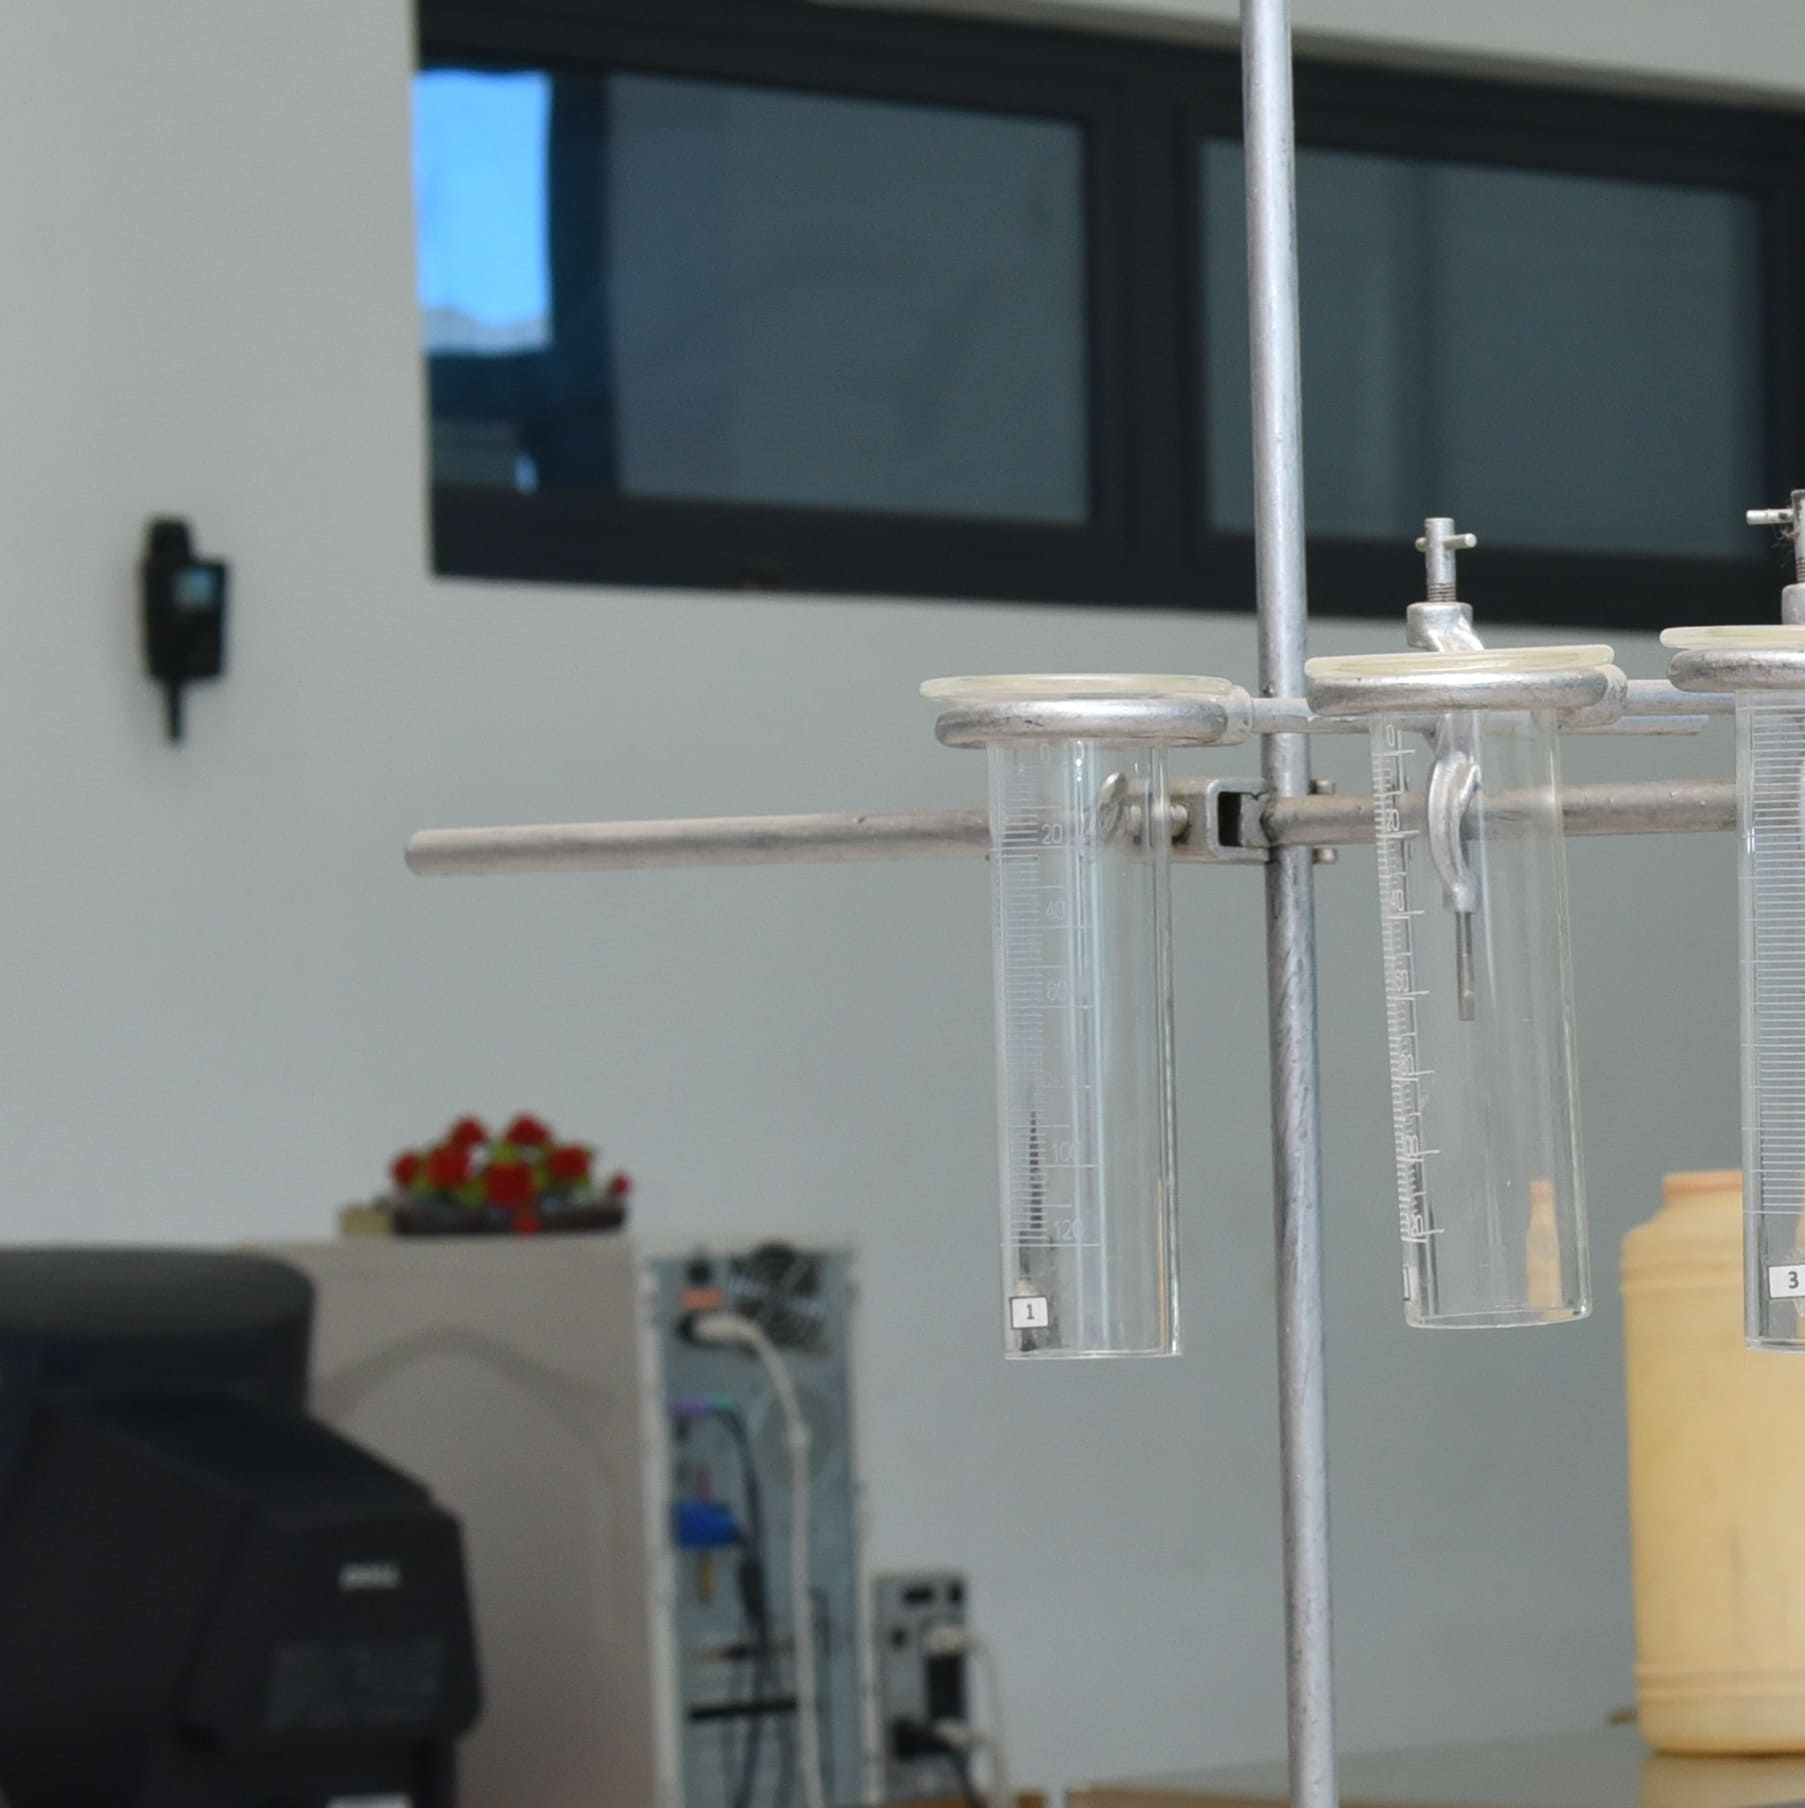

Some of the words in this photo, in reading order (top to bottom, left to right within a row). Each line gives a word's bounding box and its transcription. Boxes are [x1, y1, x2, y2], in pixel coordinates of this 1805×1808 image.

[1041, 824, 1064, 845] 20
[1787, 1271, 1800, 1290] 3
[1025, 1303, 1036, 1321] 1
